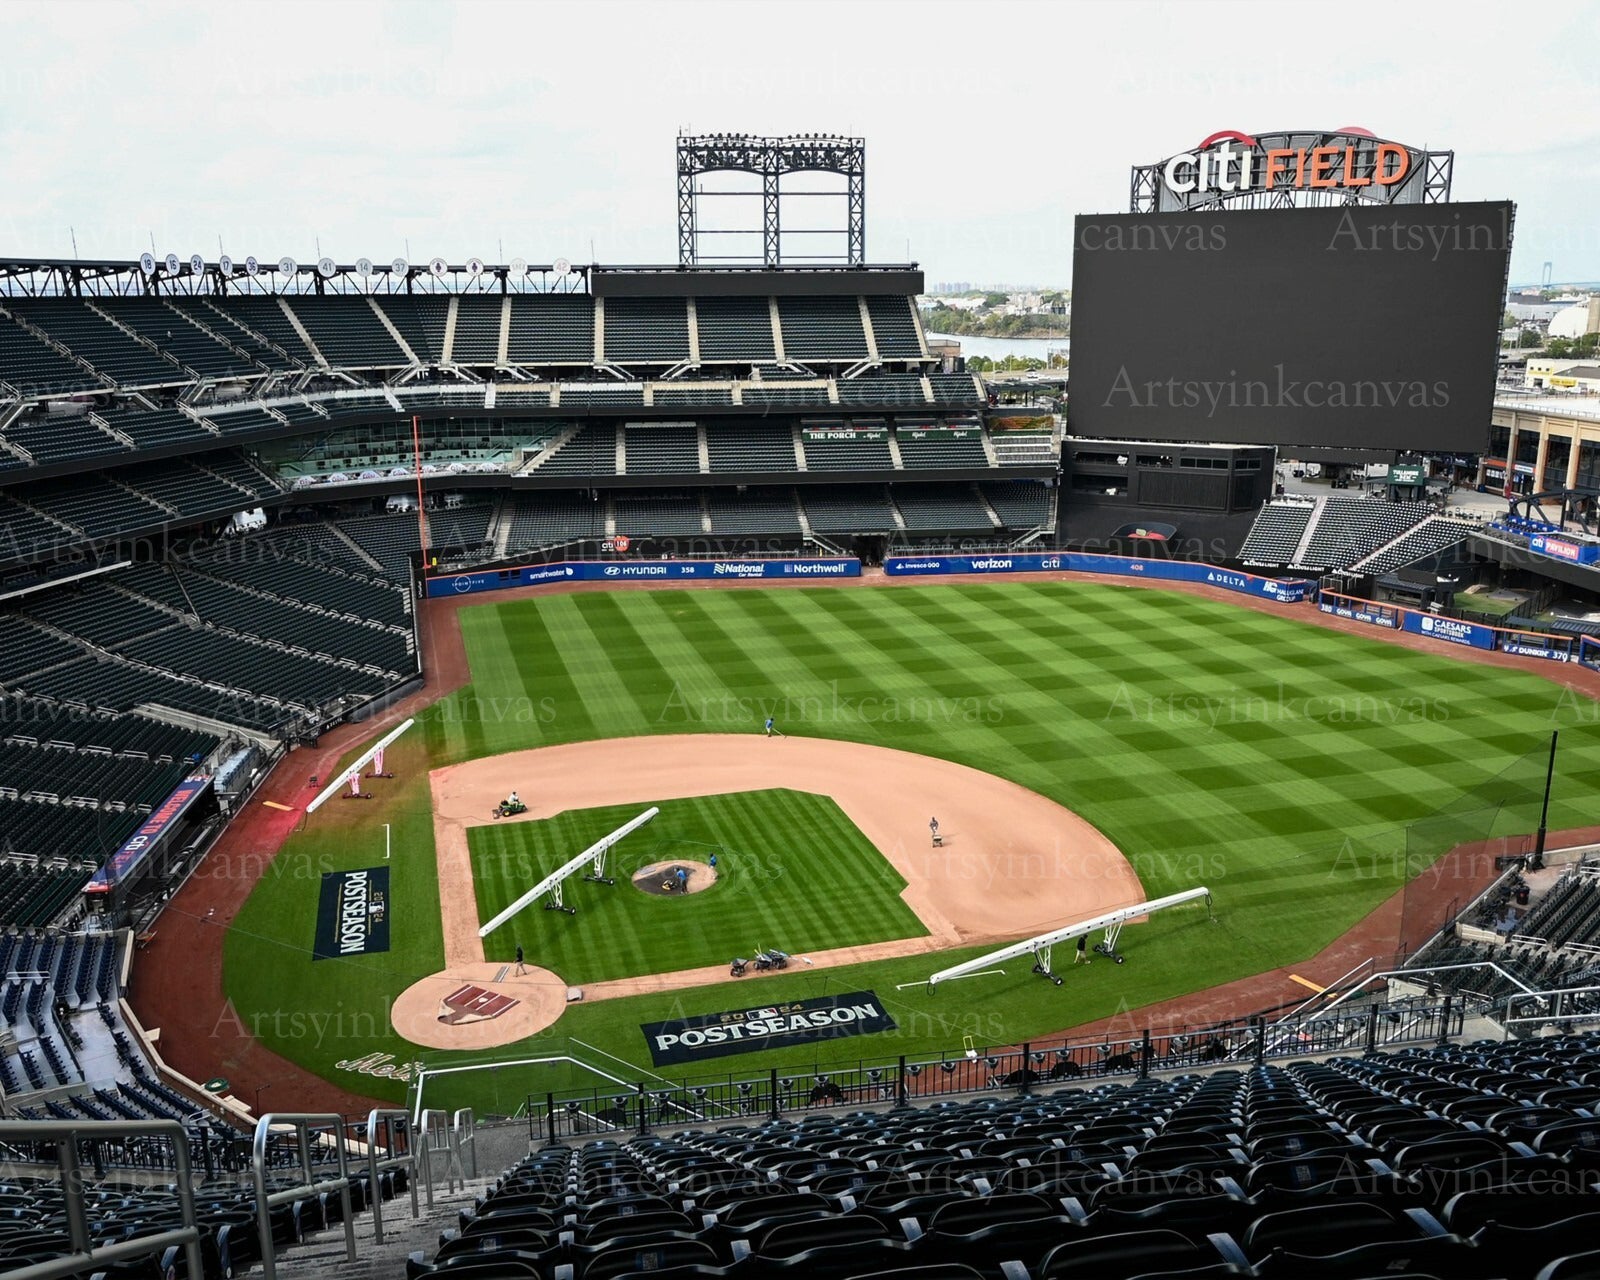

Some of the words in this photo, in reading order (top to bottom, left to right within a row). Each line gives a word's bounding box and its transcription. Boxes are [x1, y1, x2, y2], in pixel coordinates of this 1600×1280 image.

[1164, 141, 1252, 193] citi
[1266, 143, 1410, 188] FIELD
[193, 260, 202, 270] 24
[223, 261, 229, 271] 17
[283, 262, 293, 271] 31
[322, 263, 332, 271] 41
[359, 263, 368, 271] 14
[395, 263, 405, 272] 37
[557, 263, 567, 272] 42
[1532, 537, 1544, 548] citi
[1546, 541, 1576, 557] PAVILION
[972, 558, 1012, 570] verizon
[1042, 557, 1060, 568] citi
[623, 567, 667, 575] HYUNDAI
[724, 564, 764, 573] National
[794, 564, 844, 573] Northwell
[530, 569, 565, 580] smartwater
[1216, 573, 1245, 587] DELTA
[1336, 608, 1352, 617] GOYA
[1355, 613, 1371, 622] GOYA
[1375, 617, 1392, 627] GOYA
[1434, 619, 1472, 634] CAESARS
[1434, 627, 1465, 638] SPORTSBOOK
[125, 836, 148, 850] citi
[340, 871, 367, 954] POSTSEASON
[720, 1013, 745, 1023] 20
[779, 1003, 804, 1013] 24
[655, 1003, 880, 1051] POSTSEASON
